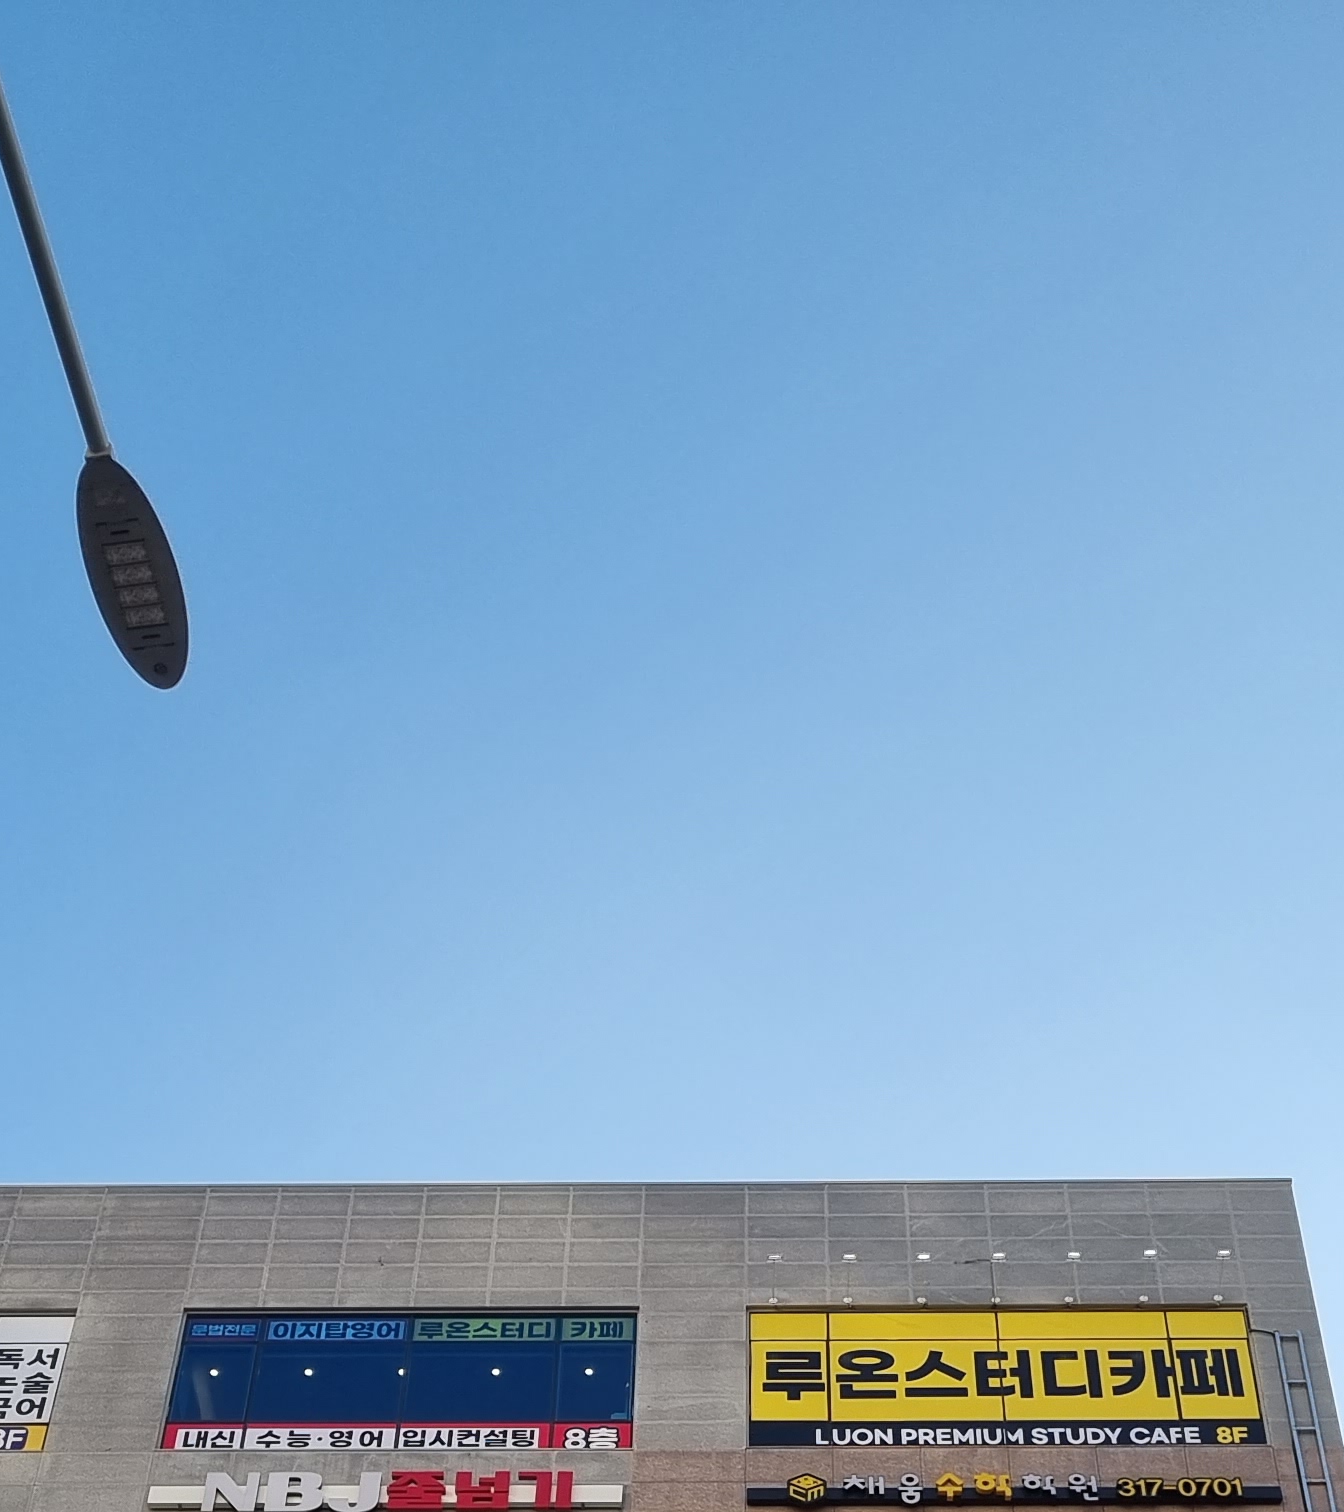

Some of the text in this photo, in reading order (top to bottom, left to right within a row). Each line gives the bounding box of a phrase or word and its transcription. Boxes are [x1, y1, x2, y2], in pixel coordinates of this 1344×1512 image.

[272, 1321, 401, 1340] 이지탑영어
[417, 1321, 552, 1339] 루온스터디
[569, 1320, 625, 1339] 카페
[762, 1348, 1246, 1401] 루온스터디카페
[182, 1430, 236, 1449] 내신
[401, 1429, 536, 1448] 입시컨설팅
[563, 1426, 620, 1450] 8층
[814, 1425, 1249, 1446] LUON PREMIUM STUDY CAFE 8F
[842, 1472, 1100, 1504] 채움수학학원
[1116, 1476, 1245, 1498] 317-0701
